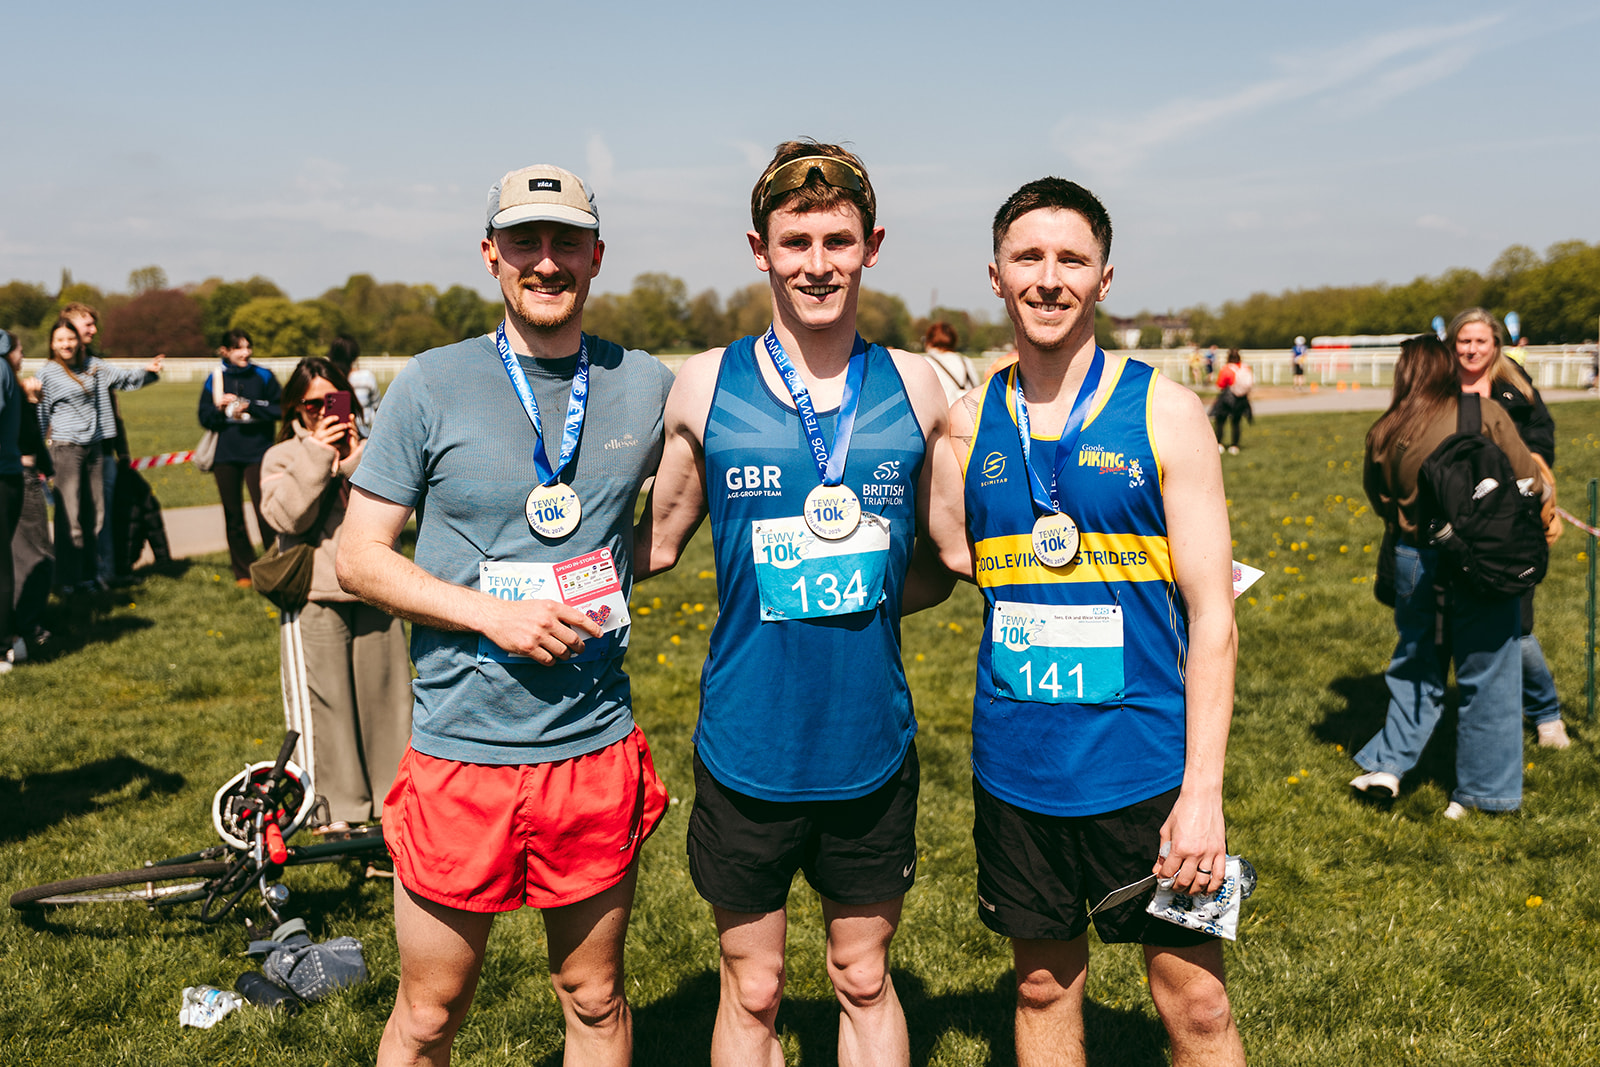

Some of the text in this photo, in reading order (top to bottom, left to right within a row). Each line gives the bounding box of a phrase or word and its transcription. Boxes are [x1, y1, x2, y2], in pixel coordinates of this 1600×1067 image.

[766, 339, 789, 371] TEWV
[604, 439, 639, 450] ellesse
[1082, 443, 1105, 452] Goole
[811, 437, 829, 469] 2026
[1079, 450, 1125, 468] VIKING
[726, 466, 782, 490] GBR
[728, 491, 763, 499] AGE-GROUP
[863, 484, 905, 496] BRITISH
[532, 497, 558, 509] TEWV
[812, 498, 839, 507] TEWV
[863, 497, 904, 506] TRIATHLON
[535, 505, 566, 523] 10k
[813, 506, 844, 522] 10k
[760, 532, 795, 544] TEWV
[1038, 528, 1061, 539] TEWV
[1040, 536, 1066, 553] 10k
[762, 542, 802, 563] 10k
[1073, 550, 1148, 566] STRIDERS
[555, 563, 572, 573] SPEND
[487, 575, 522, 587] TEWV
[791, 569, 868, 613] 134
[1001, 614, 1027, 626] TEWV
[1000, 626, 1030, 645] 10k
[1019, 660, 1083, 698] 141
